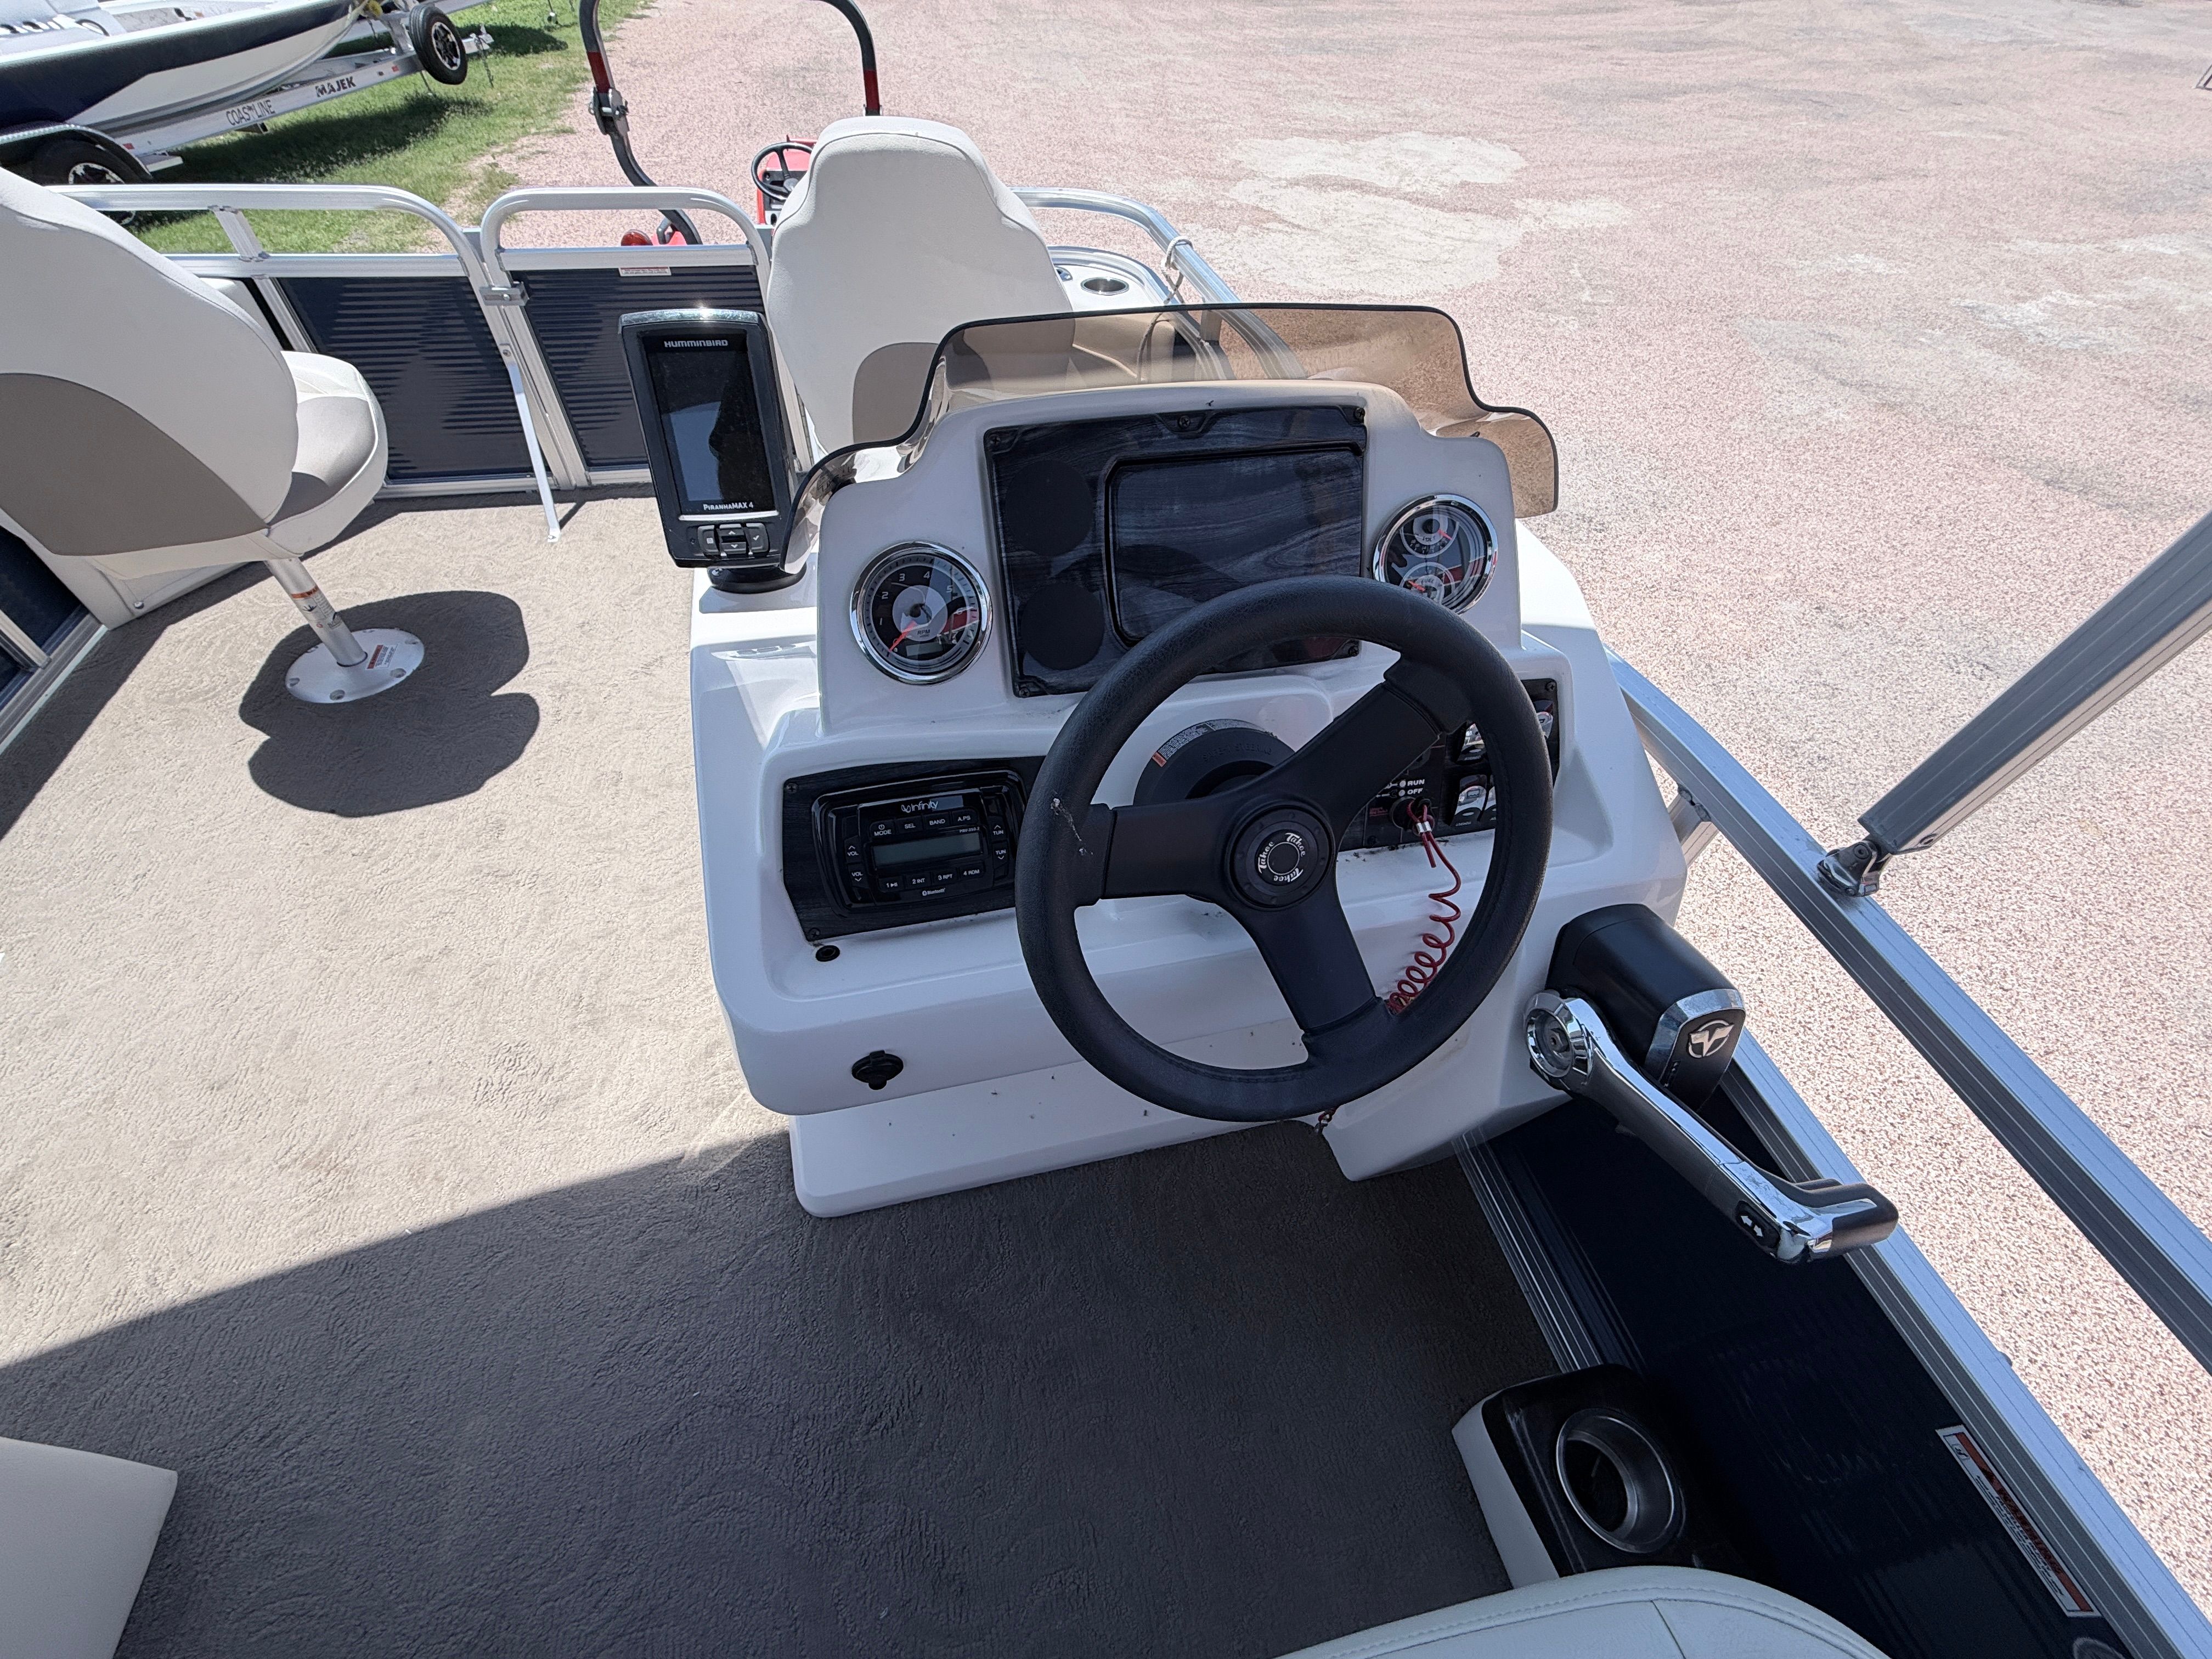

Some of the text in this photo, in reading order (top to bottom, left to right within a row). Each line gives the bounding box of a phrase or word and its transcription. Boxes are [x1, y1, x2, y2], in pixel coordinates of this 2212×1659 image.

[315, 76, 357, 98] MAJEK
[226, 99, 275, 126] COASTLINE
[664, 339, 729, 348] HUMMINBIRD
[899, 573, 905, 582] 3
[923, 571, 930, 579] 4
[946, 585, 953, 593] 5
[881, 591, 889, 600] 2
[1284, 832, 1307, 857] Tahoe
[1257, 841, 1275, 874] Tahoe
[1273, 867, 1304, 883] Tahoe
